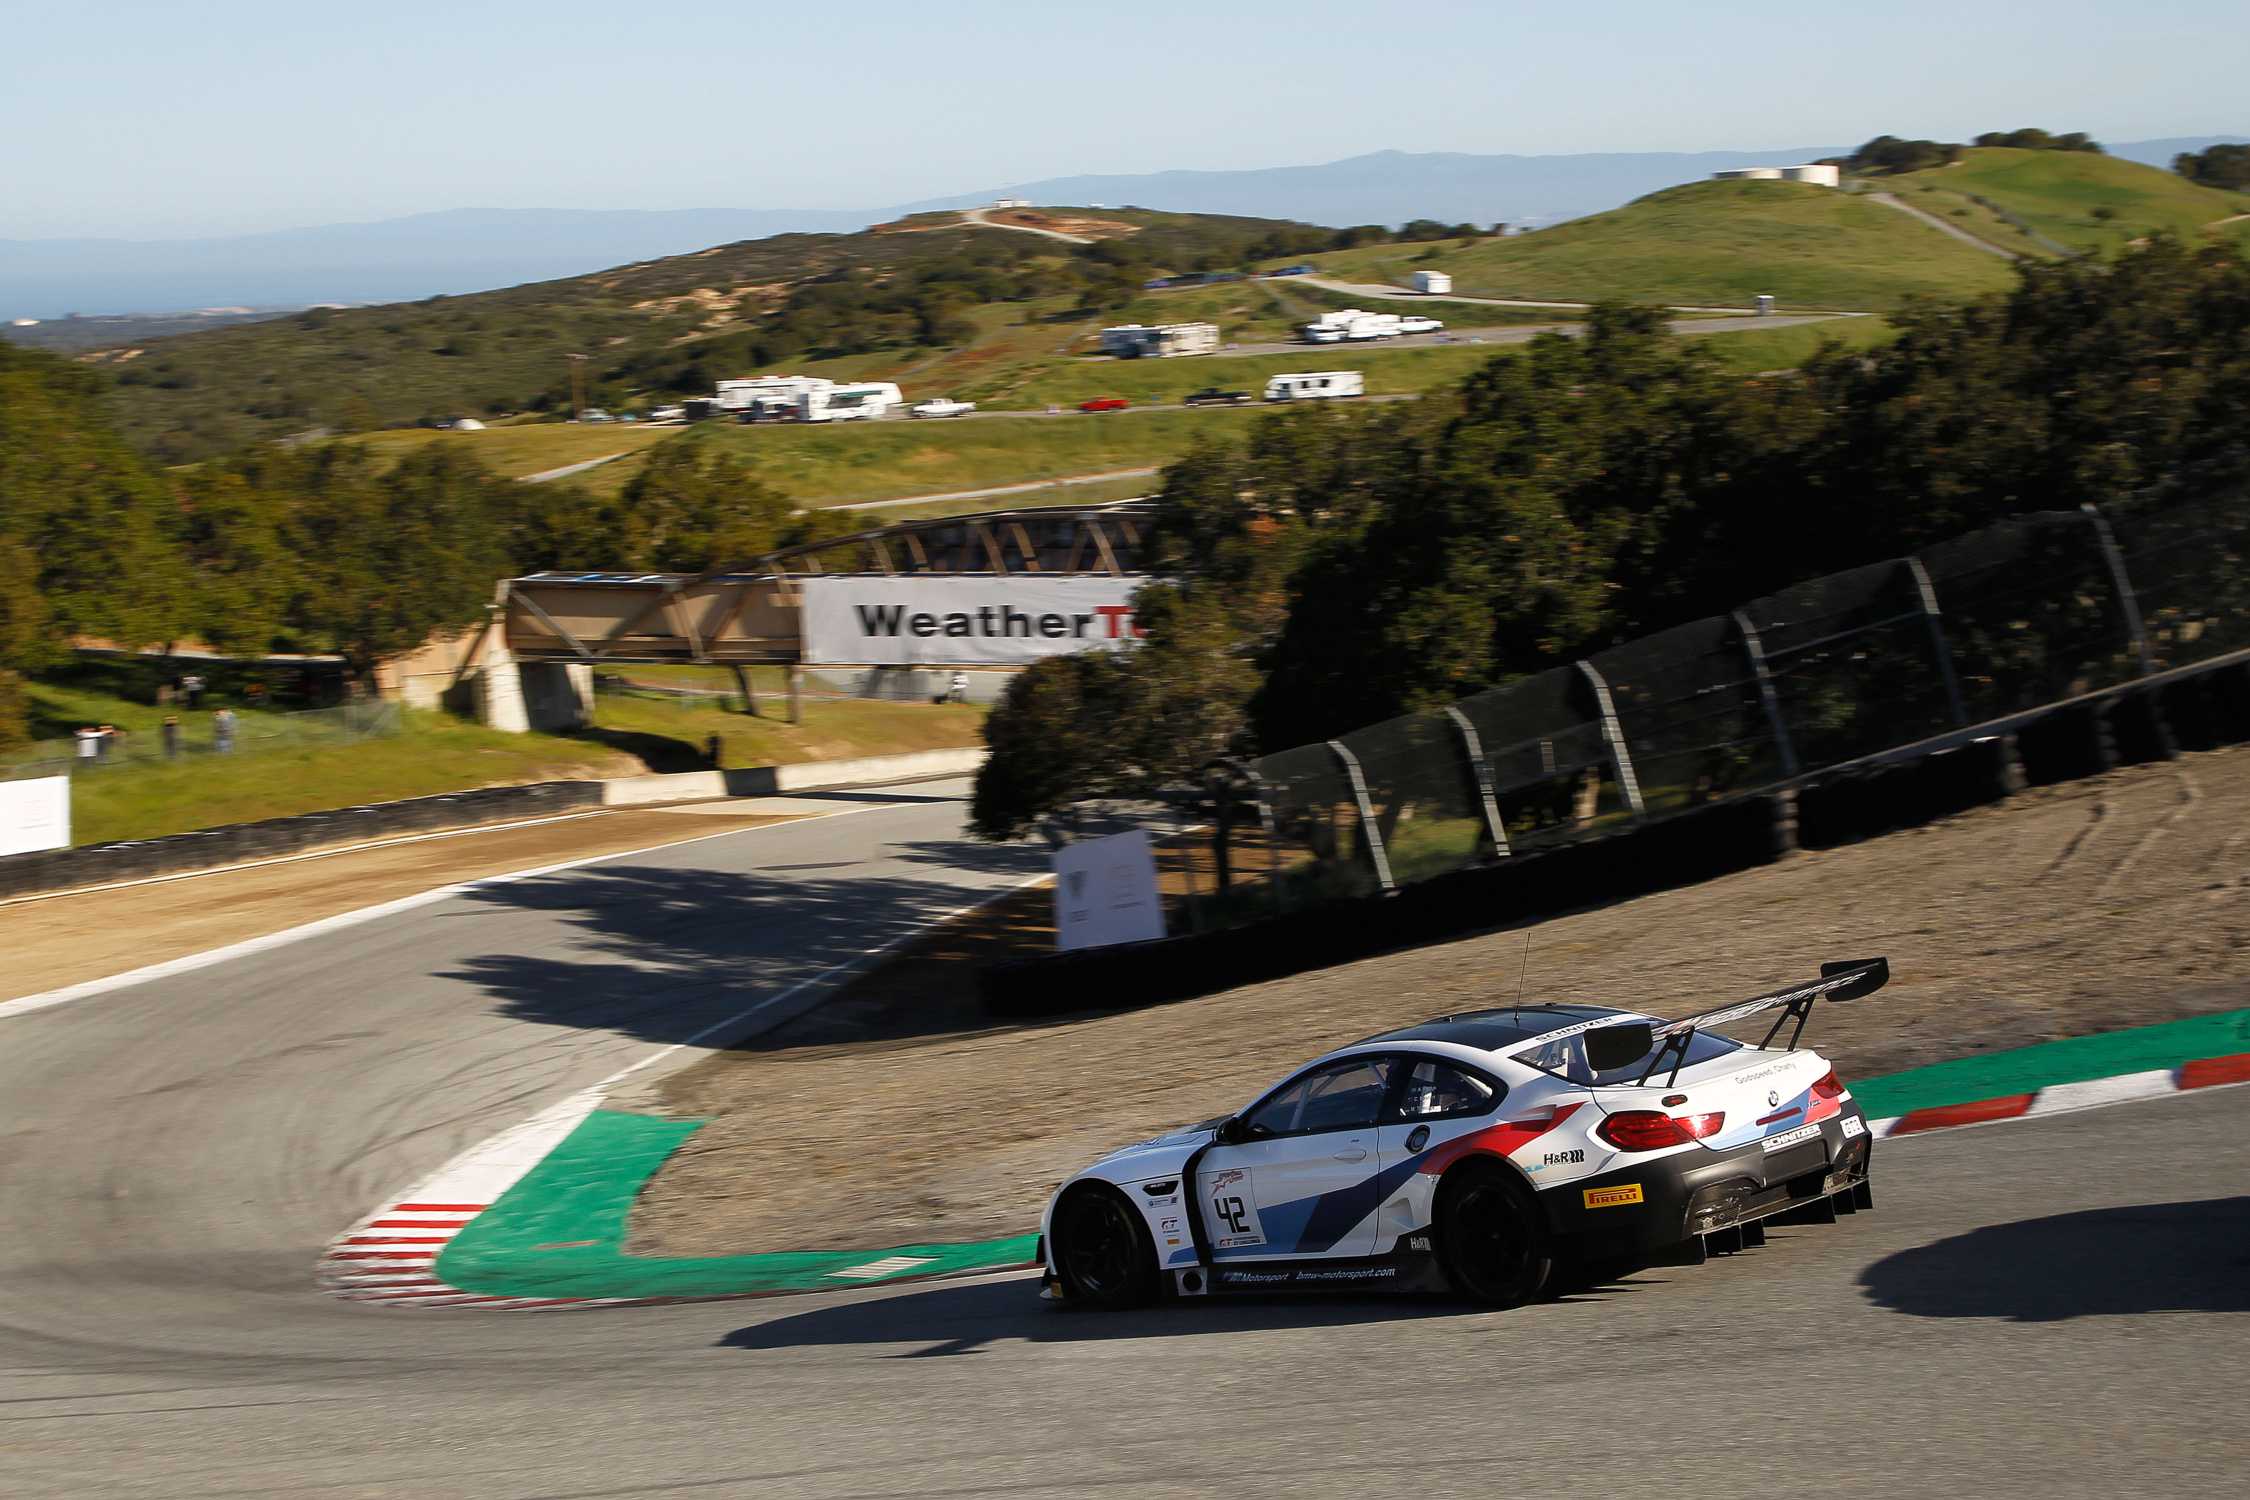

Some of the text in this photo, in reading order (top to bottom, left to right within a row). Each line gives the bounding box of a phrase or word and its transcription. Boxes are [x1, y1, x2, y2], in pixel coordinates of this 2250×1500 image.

[1535, 1017, 1614, 1042] SCHNITZER
[1762, 1124, 1822, 1149] SCHNITZER
[1588, 1187, 1637, 1205] PIRELLI
[1213, 1197, 1251, 1234] 42
[1242, 1270, 1289, 1283] Motorsport
[1296, 1267, 1396, 1283] bmw-motorsport.com
